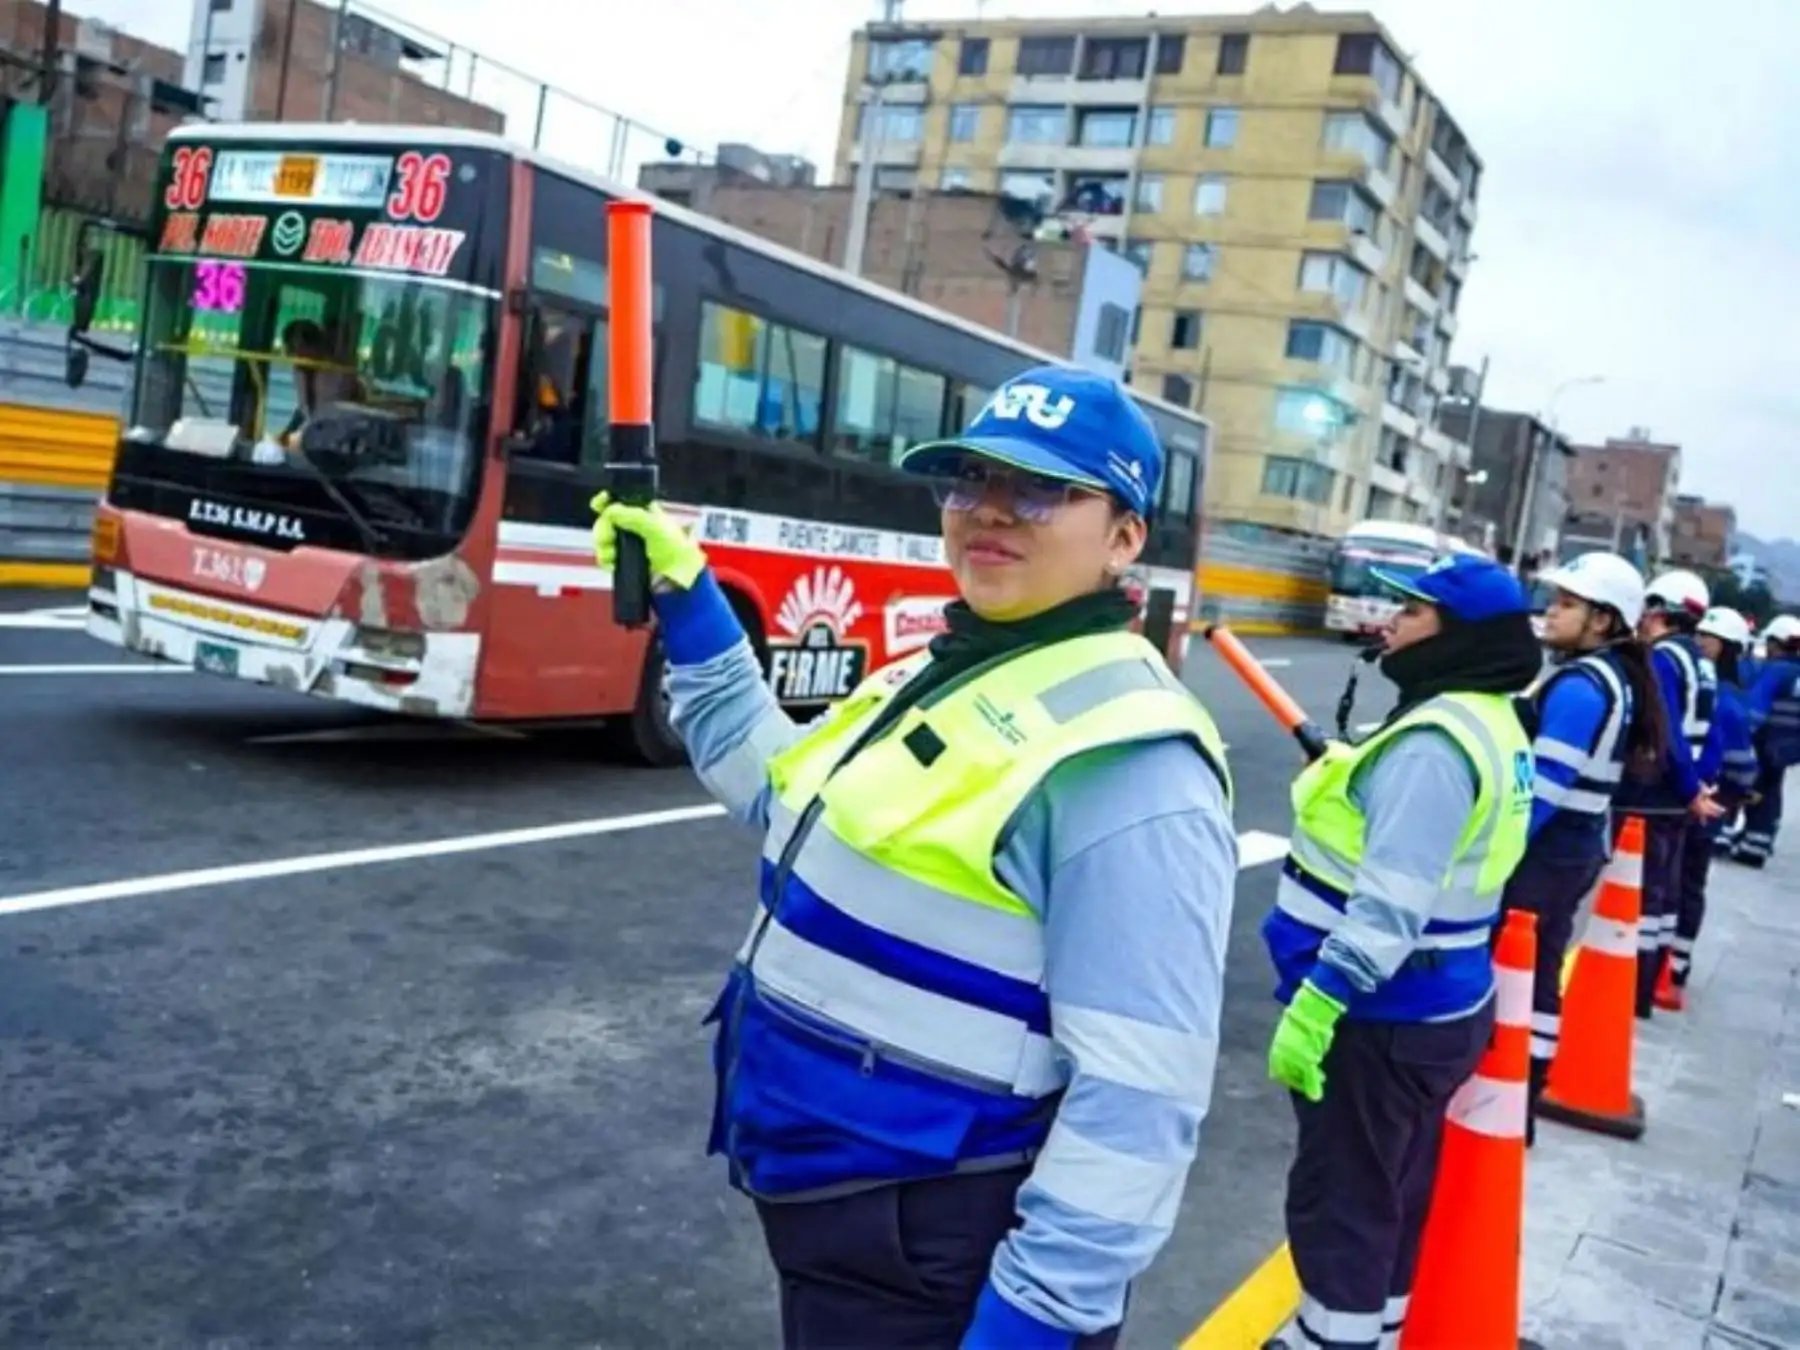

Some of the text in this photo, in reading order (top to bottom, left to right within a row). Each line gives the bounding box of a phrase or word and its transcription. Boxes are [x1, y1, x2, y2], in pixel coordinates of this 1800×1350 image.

[164, 146, 212, 209] 36
[386, 152, 450, 221] 36
[191, 258, 246, 312] 36
[770, 649, 856, 698] FIRME
